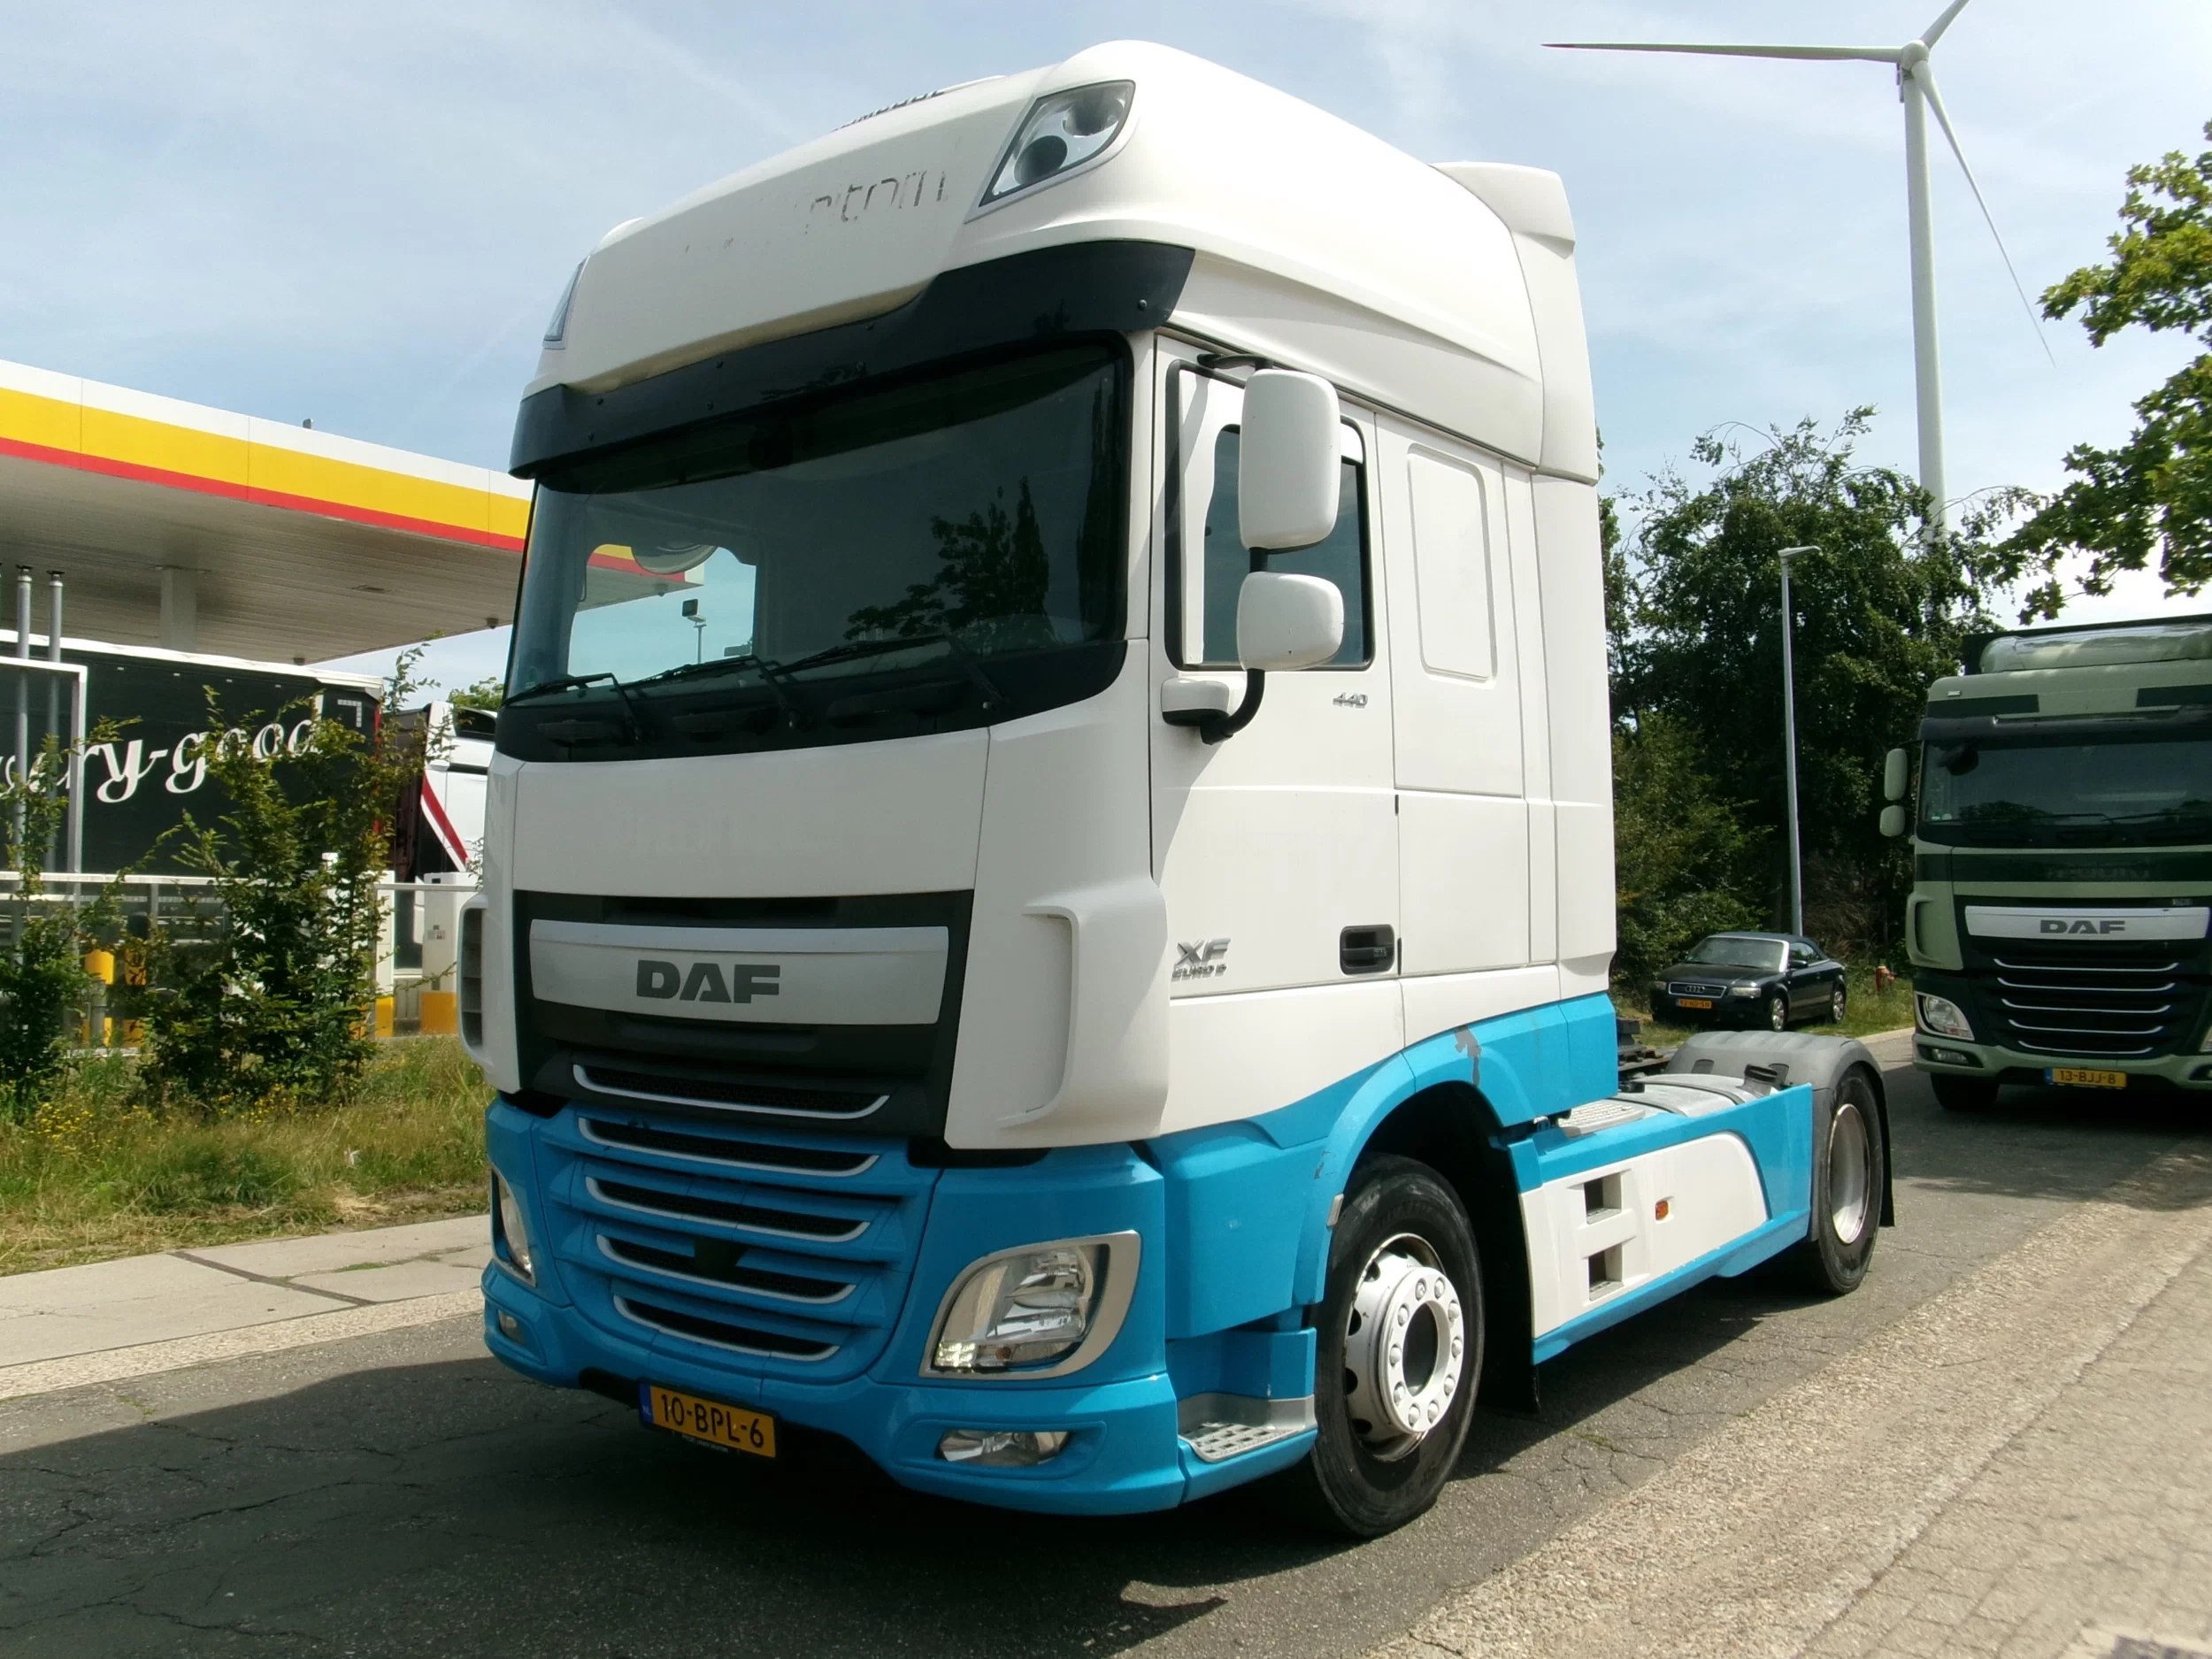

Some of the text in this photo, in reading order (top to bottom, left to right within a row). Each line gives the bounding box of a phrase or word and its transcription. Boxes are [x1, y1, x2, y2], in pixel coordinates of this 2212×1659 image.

[1333, 692, 1369, 709] 440
[2040, 919, 2125, 934] DAF
[1174, 938, 1232, 965] XF
[636, 959, 780, 1003] DAF
[1171, 964, 1215, 981] EURO
[2059, 1070, 2116, 1085] 13-BJJ-8
[661, 1394, 764, 1448] 10-BPL-6
